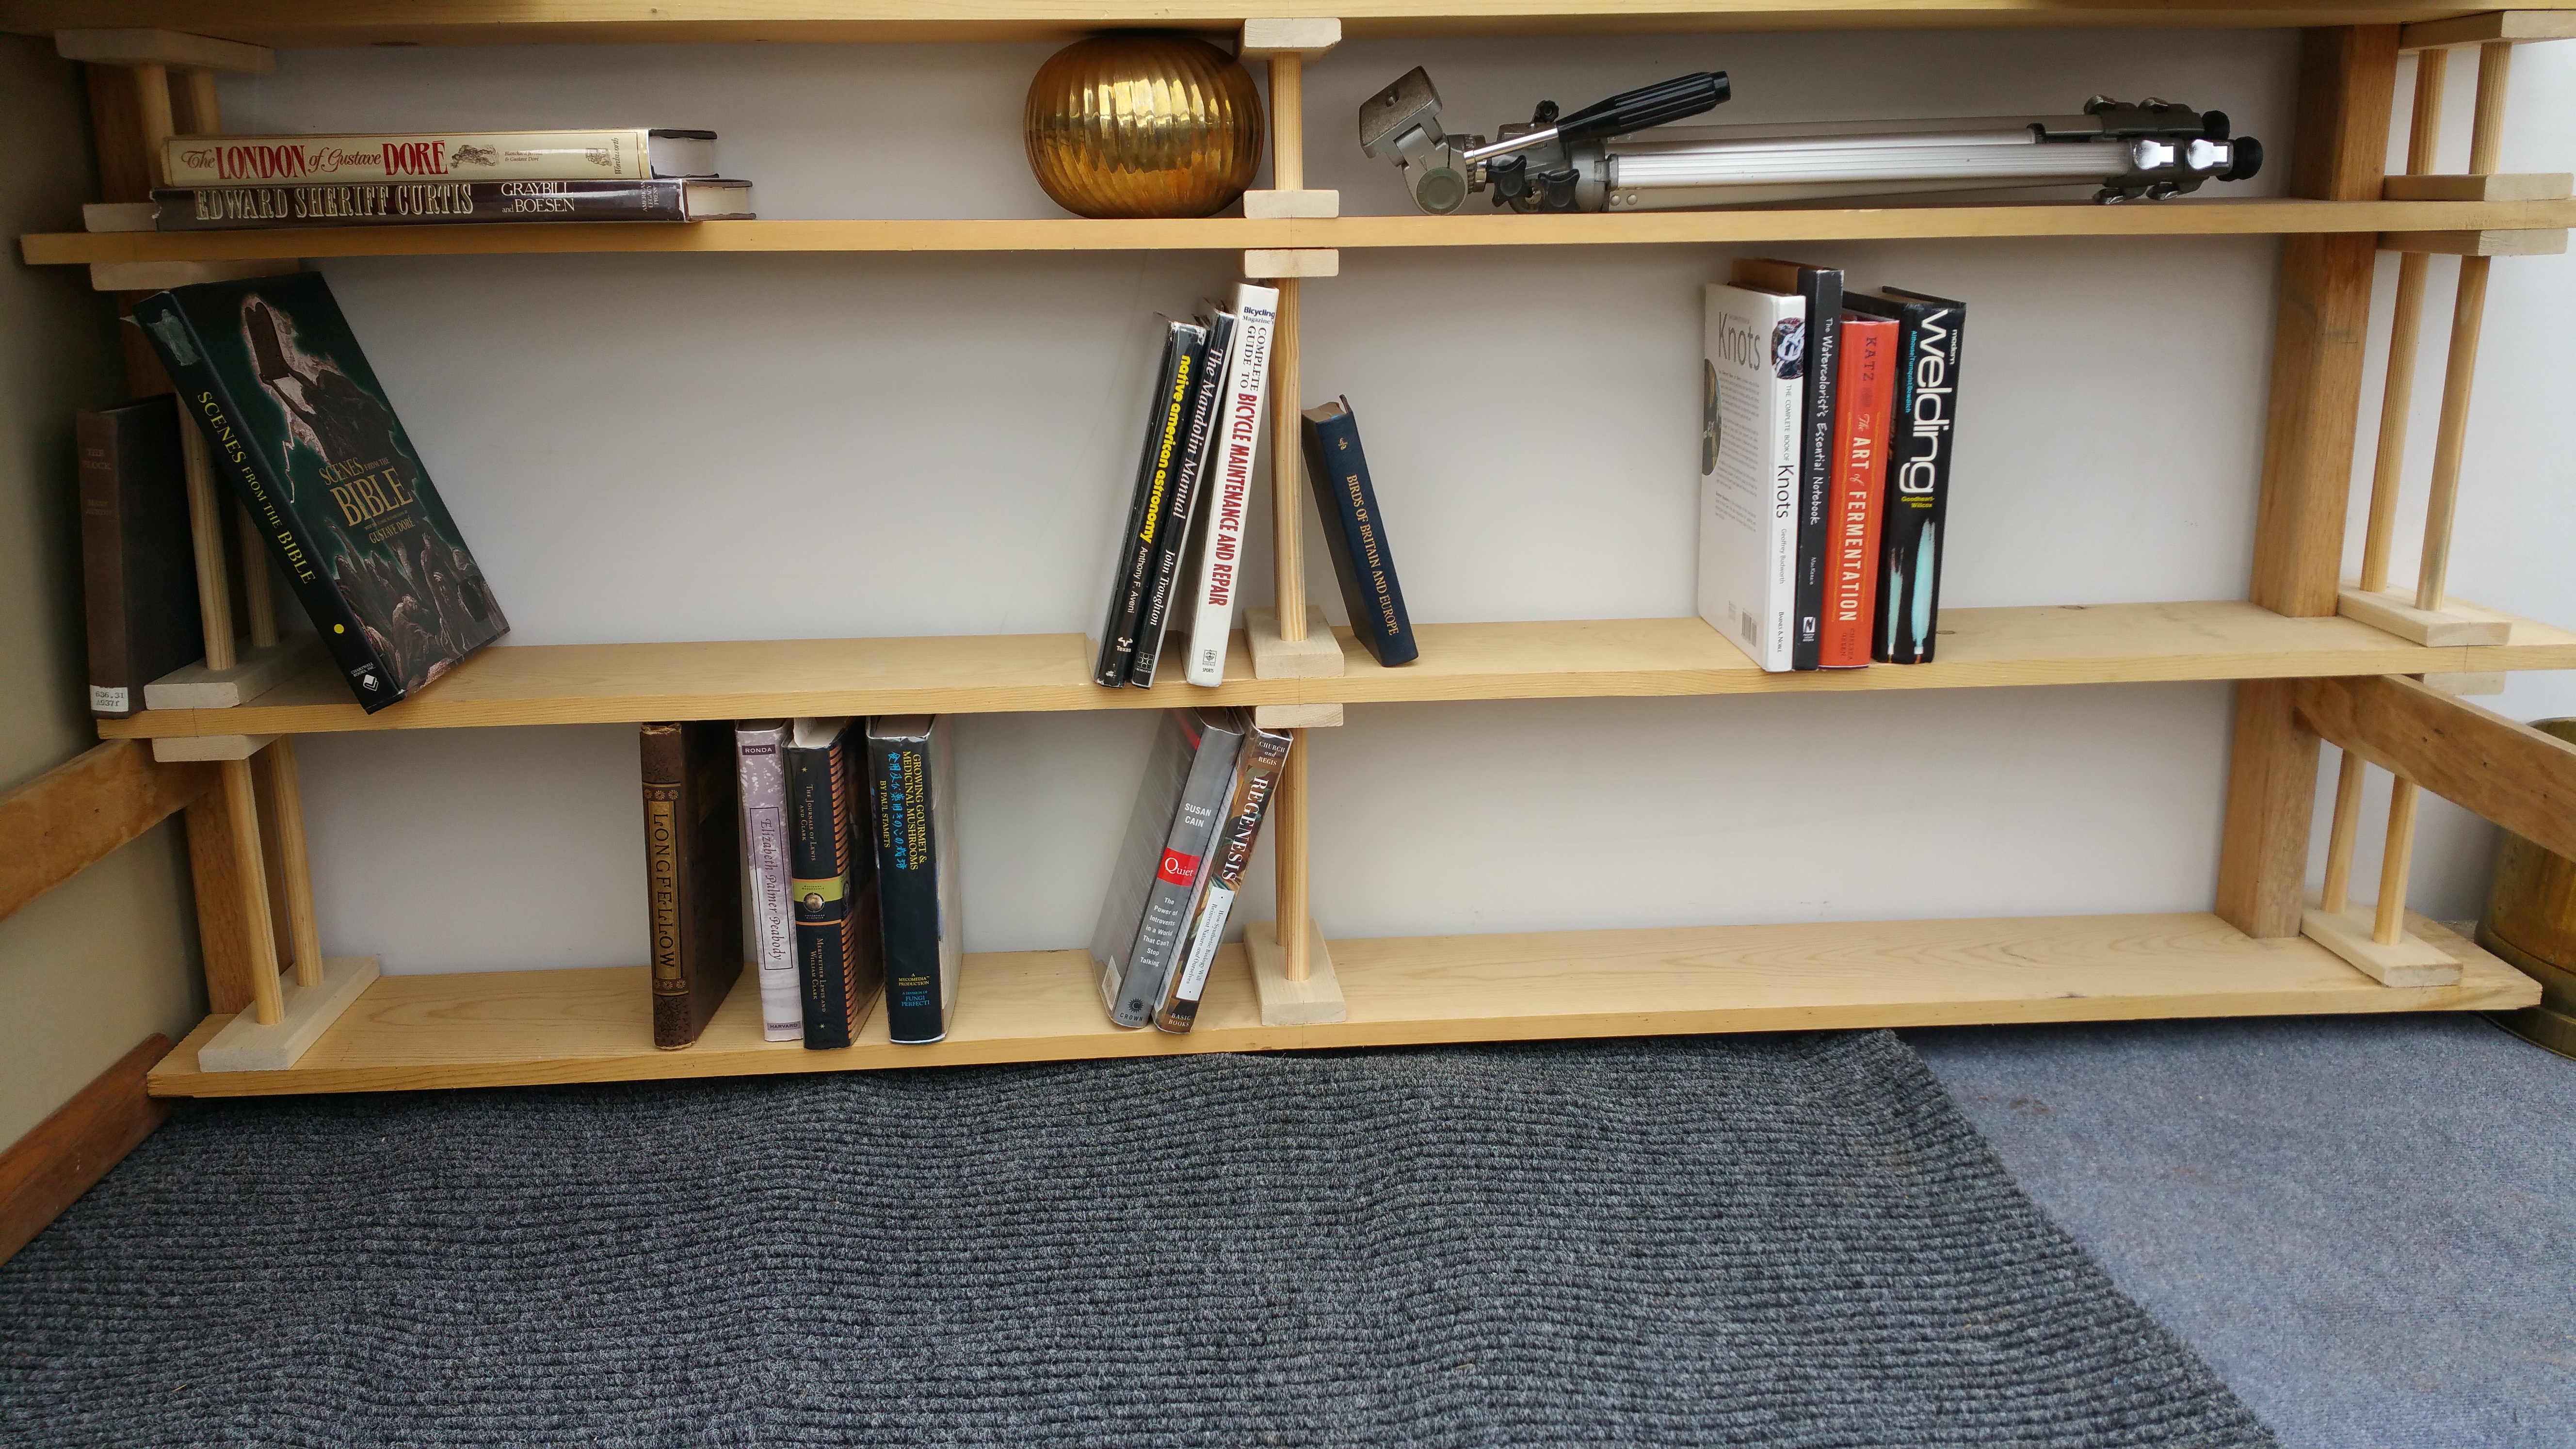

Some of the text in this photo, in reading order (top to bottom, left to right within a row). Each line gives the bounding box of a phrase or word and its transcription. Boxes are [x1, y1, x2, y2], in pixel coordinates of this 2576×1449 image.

[181, 149, 215, 168] The
[215, 145, 307, 179] LONDON
[308, 147, 330, 173] of
[321, 148, 381, 172] Gustave
[611, 138, 622, 175] Wordsworth
[196, 183, 474, 221] EDWARD SHERIFF CURTIS
[501, 182, 574, 196] GRAYBILL
[502, 198, 575, 213] and BOESEN
[1242, 315, 1274, 324] Magazine's
[1244, 306, 1275, 319] Bicycling
[1825, 318, 1833, 333] The
[1719, 311, 1760, 370] Knots
[1949, 329, 1958, 365] modern
[1240, 325, 1256, 388] GUIDE TO
[1251, 327, 1267, 391] COMPLETE
[1863, 337, 1877, 382] KATZ
[1173, 355, 1191, 402] native
[1816, 335, 1833, 418] Watercolorist's
[1899, 309, 1952, 493] welding
[1159, 402, 1181, 468] american
[1814, 422, 1828, 473] Essential
[1784, 453, 1789, 461] OF
[1851, 437, 1872, 470] ART
[319, 457, 365, 485] SCENES
[364, 462, 379, 471] FROM
[1850, 473, 1864, 485] of
[198, 392, 316, 585] SCENES FROM THE BIBLE
[330, 466, 413, 527] BIBLE
[1150, 349, 1223, 626] The Mandolin Manual John Troughton
[1208, 392, 1257, 606] BICYCLE MAINTENANCE AND REPAIR
[1776, 464, 1794, 519] Knots
[1810, 477, 1823, 525] Notebook
[1140, 469, 1167, 544] astronomy
[369, 522, 399, 544] GUSTAVE
[1133, 547, 1148, 581] Anthony
[1346, 474, 1399, 636] BIRDS OF BRITAIN AND EUROPE
[1839, 491, 1867, 621] FERMENTATION
[1127, 590, 1139, 613] Aveni
[1258, 756, 1277, 766] REGIS
[1259, 741, 1286, 753] CHURCH
[880, 780, 886, 790] BY
[913, 754, 924, 803] GROWING
[806, 798, 815, 830] JOURNALS
[903, 751, 918, 870] MEDICINAL MUSHROOMS
[1185, 803, 1211, 817] SUSAN
[1185, 816, 1205, 827] CAIN
[810, 831, 814, 839] OF
[882, 813, 890, 848] STAMETS
[916, 805, 927, 853] GOURMET
[1222, 776, 1269, 881] REGENESIS
[1164, 857, 1194, 876] Quiet
[654, 814, 674, 967] LONGFELLOW
[761, 818, 785, 960] Elizabeth Palmer Peabody
[1164, 897, 1175, 905] The
[1149, 915, 1175, 926] Introverts
[1154, 905, 1172, 915] Power
[1206, 903, 1218, 928] Reinvent
[1216, 910, 1224, 923] How
[1143, 934, 1169, 946] That Can't
[1158, 927, 1173, 936] World
[1201, 928, 1209, 947] Nature
[1208, 923, 1219, 949] Synthetic
[1140, 956, 1160, 967] Talking
[1146, 947, 1159, 956] Stop
[1199, 949, 1211, 968] Biology
[1186, 958, 1199, 984] Ourselves
[1120, 1013, 1143, 1021] CROWN
[1171, 1012, 1191, 1020] BASIC
